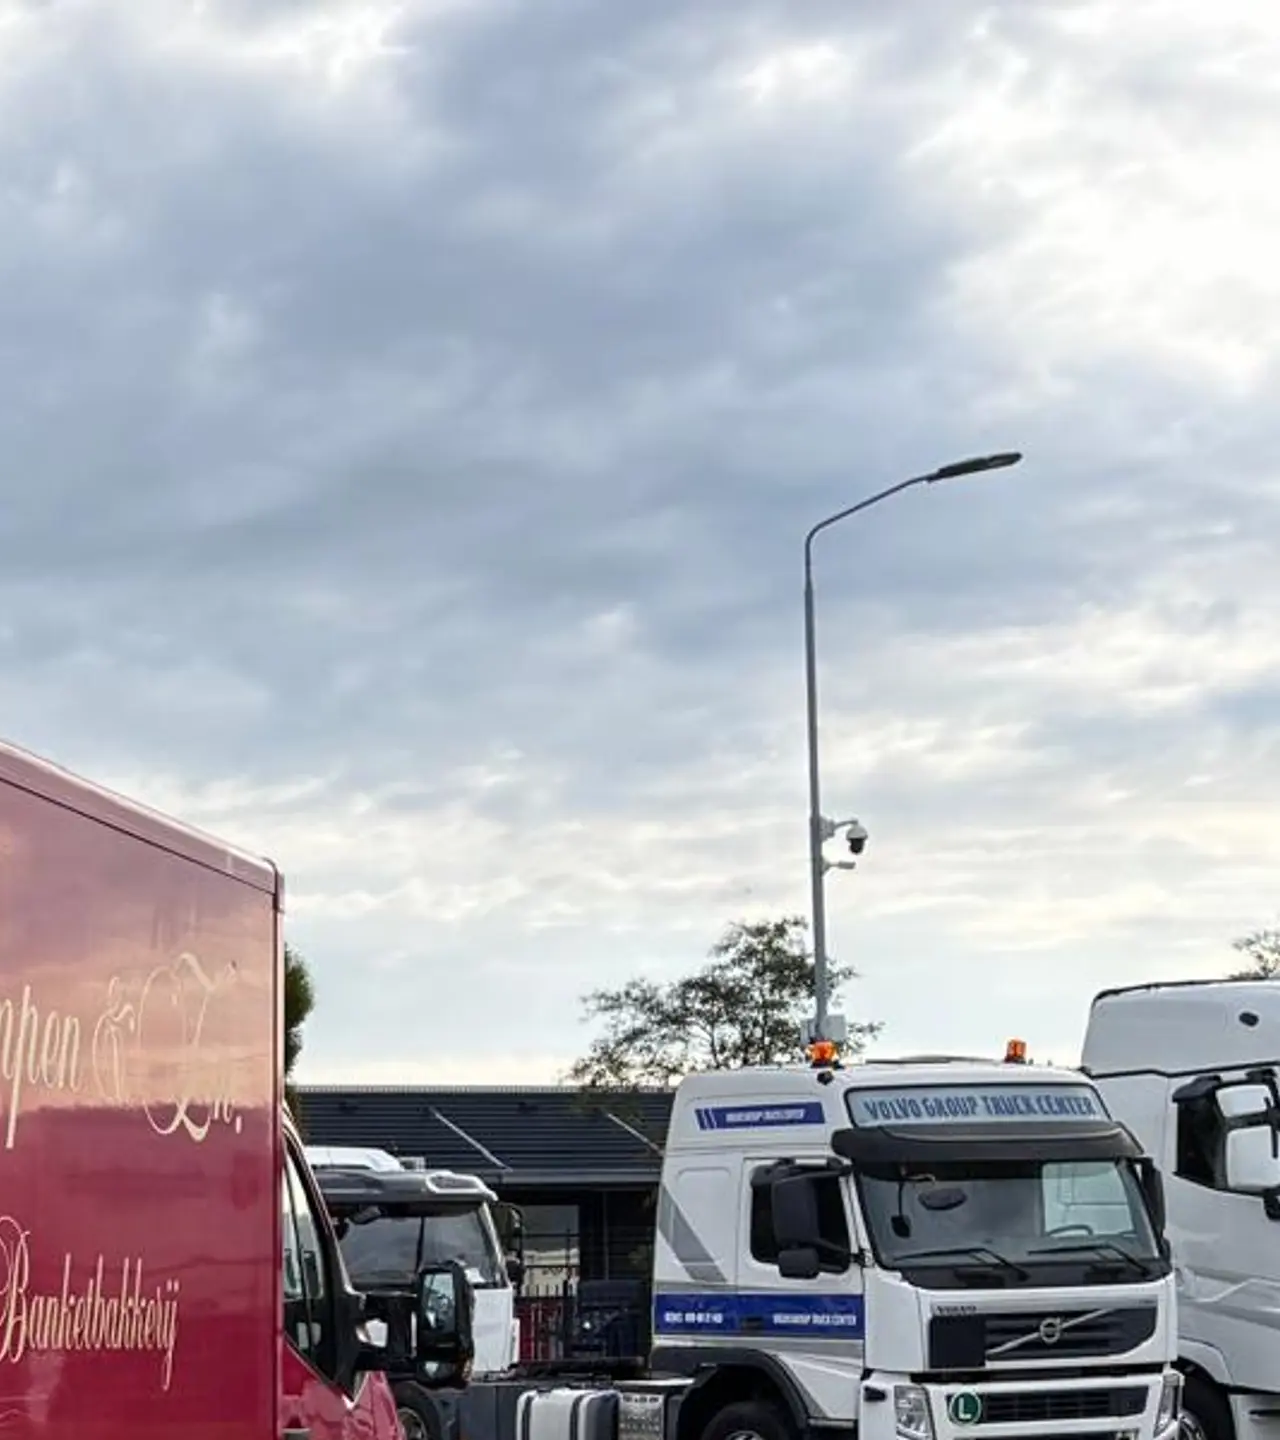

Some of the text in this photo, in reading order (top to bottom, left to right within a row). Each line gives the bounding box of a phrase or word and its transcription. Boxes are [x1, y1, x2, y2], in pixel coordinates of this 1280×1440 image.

[863, 1094, 1096, 1120] VOLVO GROUP TRUCK CENTER
[958, 1397, 971, 1419] L
